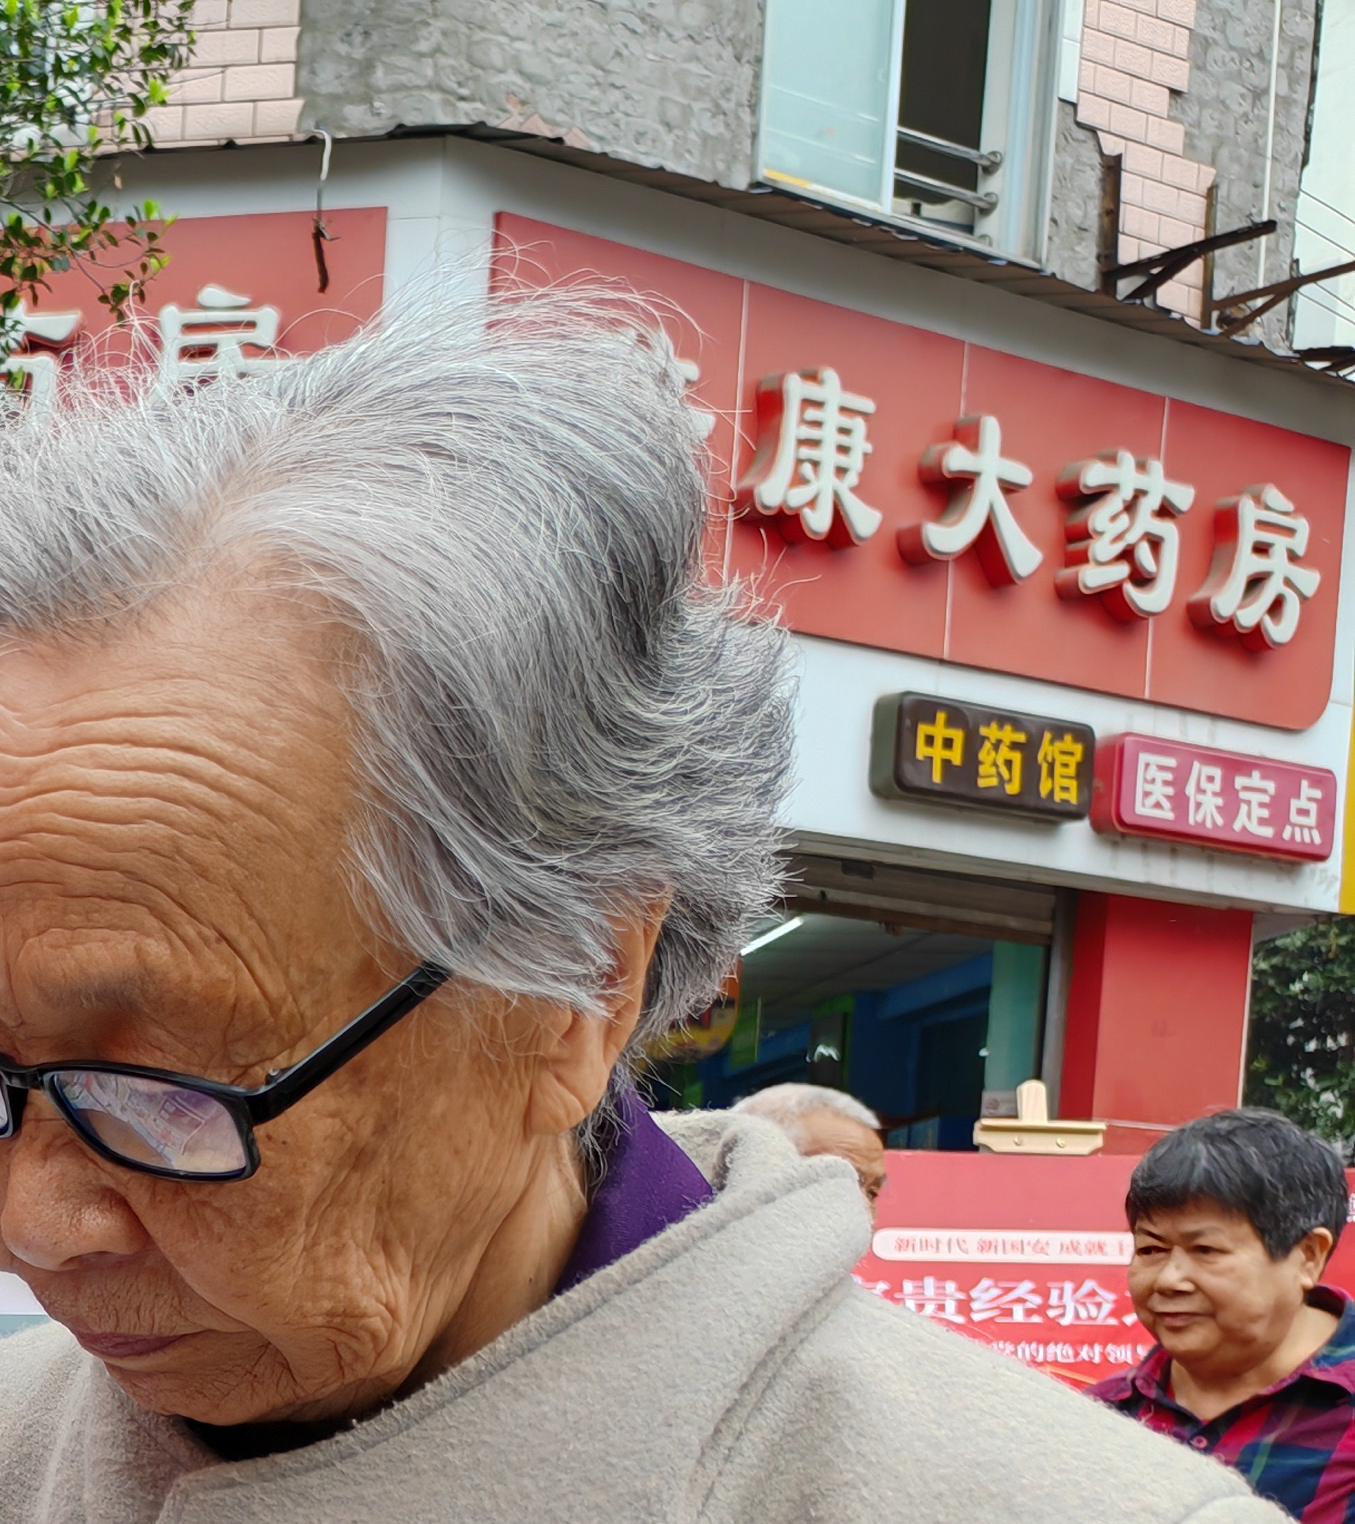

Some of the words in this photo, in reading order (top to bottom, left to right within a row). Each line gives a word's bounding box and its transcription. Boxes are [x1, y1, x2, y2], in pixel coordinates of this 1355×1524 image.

[674, 355, 1321, 652] 康大药房
[916, 711, 1084, 805] 中药馆
[1135, 752, 1323, 846] 医保定点
[851, 1275, 1138, 1327] 贵经验
[992, 1340, 1149, 1366] 的绝对领
